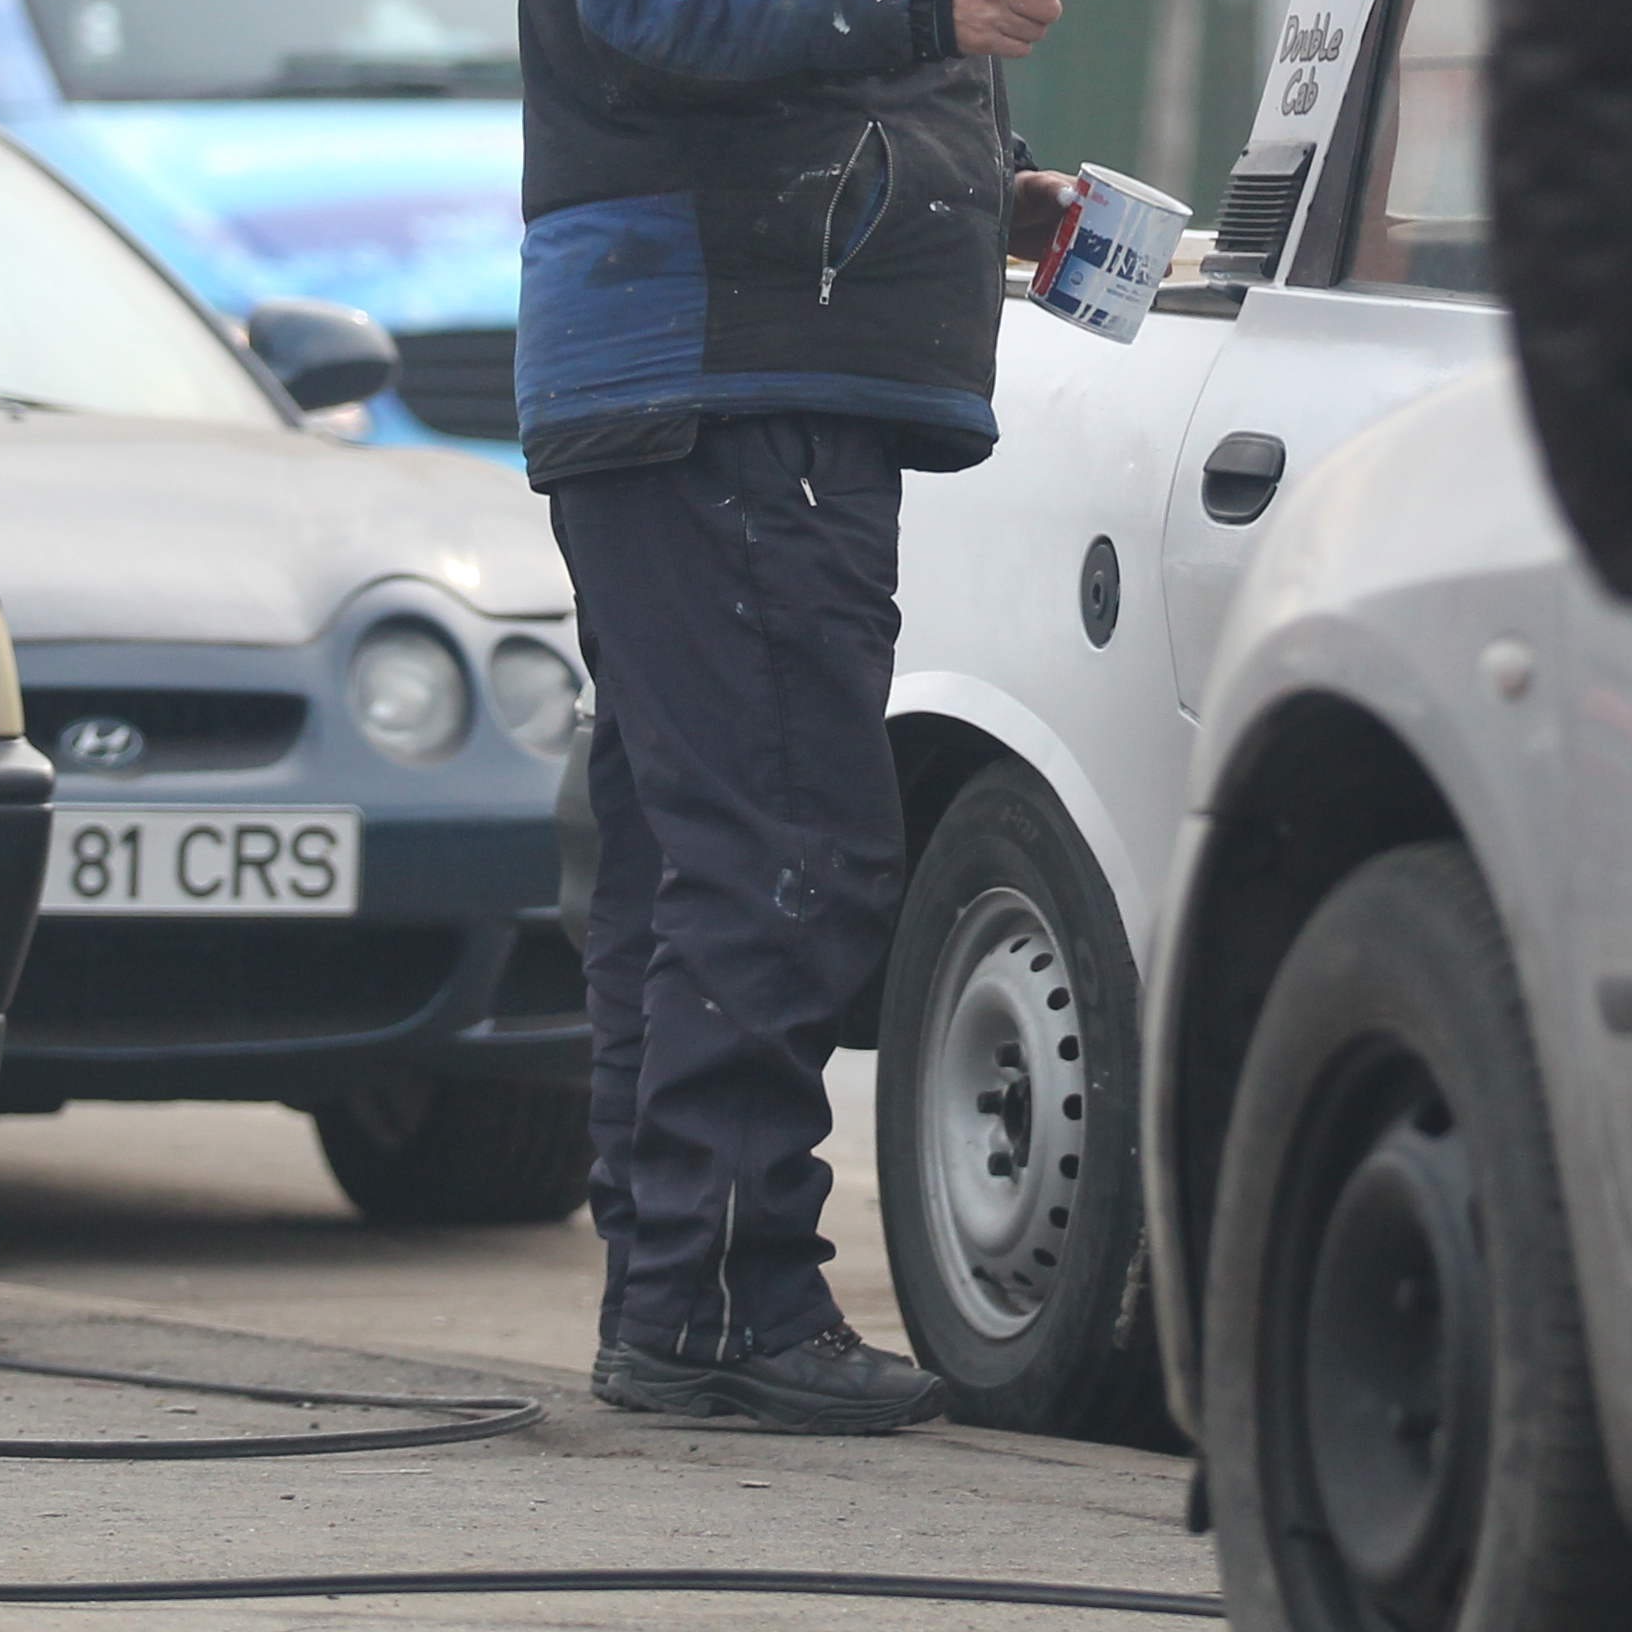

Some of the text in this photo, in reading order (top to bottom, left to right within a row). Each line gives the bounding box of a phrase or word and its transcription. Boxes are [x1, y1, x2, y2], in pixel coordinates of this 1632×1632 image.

[1279, 11, 1344, 63] Double
[1281, 66, 1319, 116] Cab
[71, 824, 339, 899] 81 CRS
